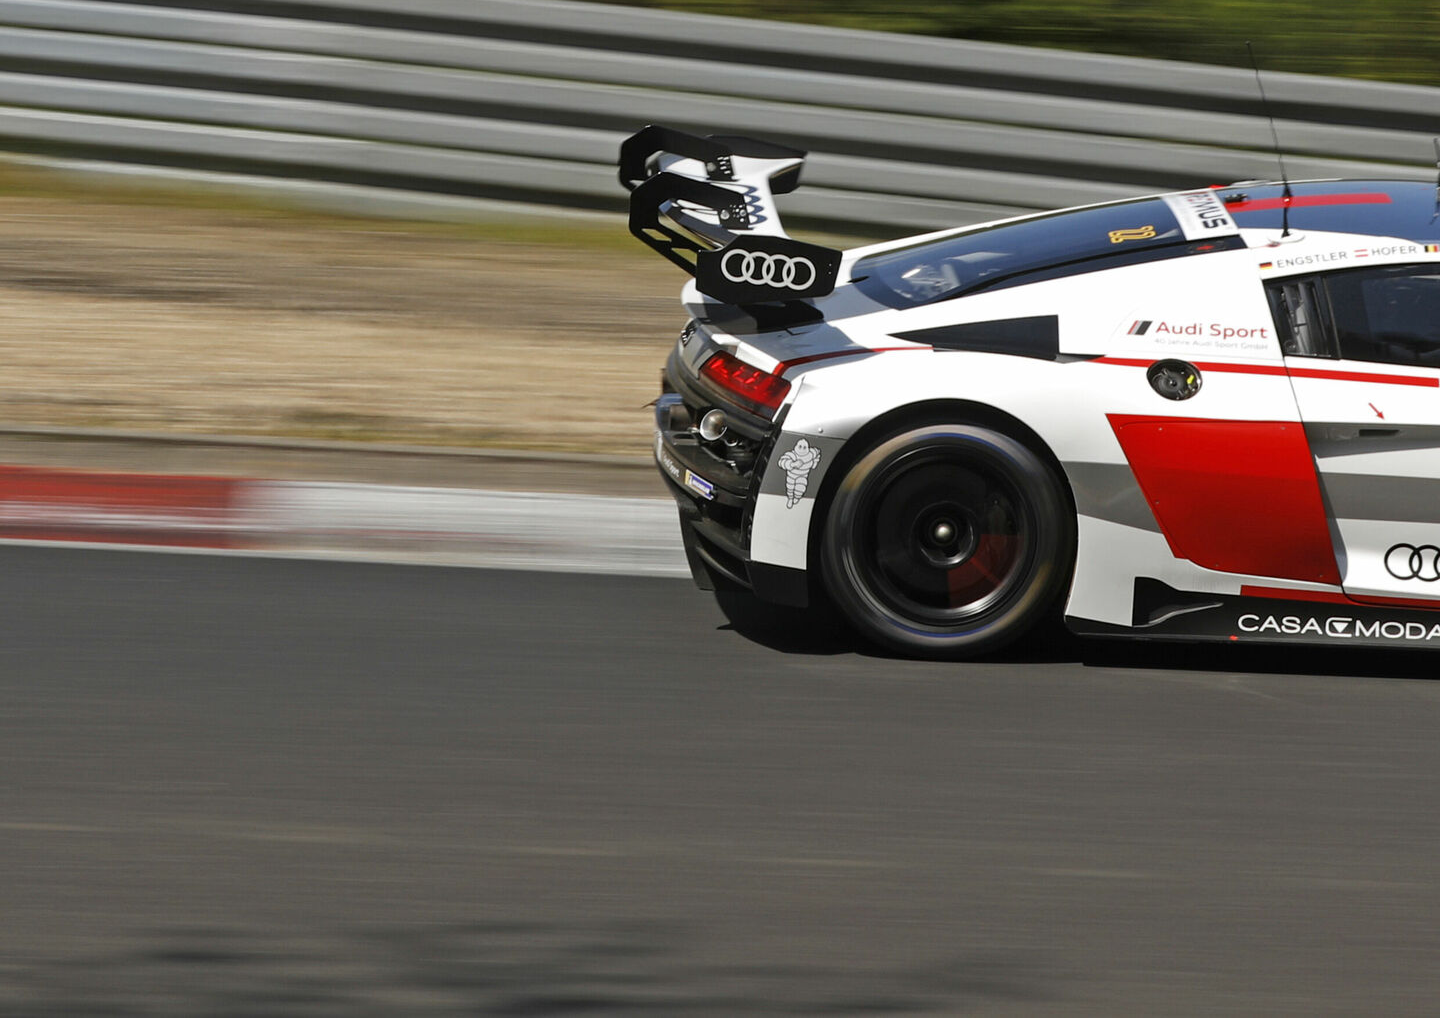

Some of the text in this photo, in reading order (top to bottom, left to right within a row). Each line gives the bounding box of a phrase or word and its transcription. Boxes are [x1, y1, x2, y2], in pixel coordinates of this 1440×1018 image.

[1277, 251, 1348, 269] ENGSTLER
[1371, 245, 1418, 257] HOFER
[1155, 321, 1269, 340] Audi Sport
